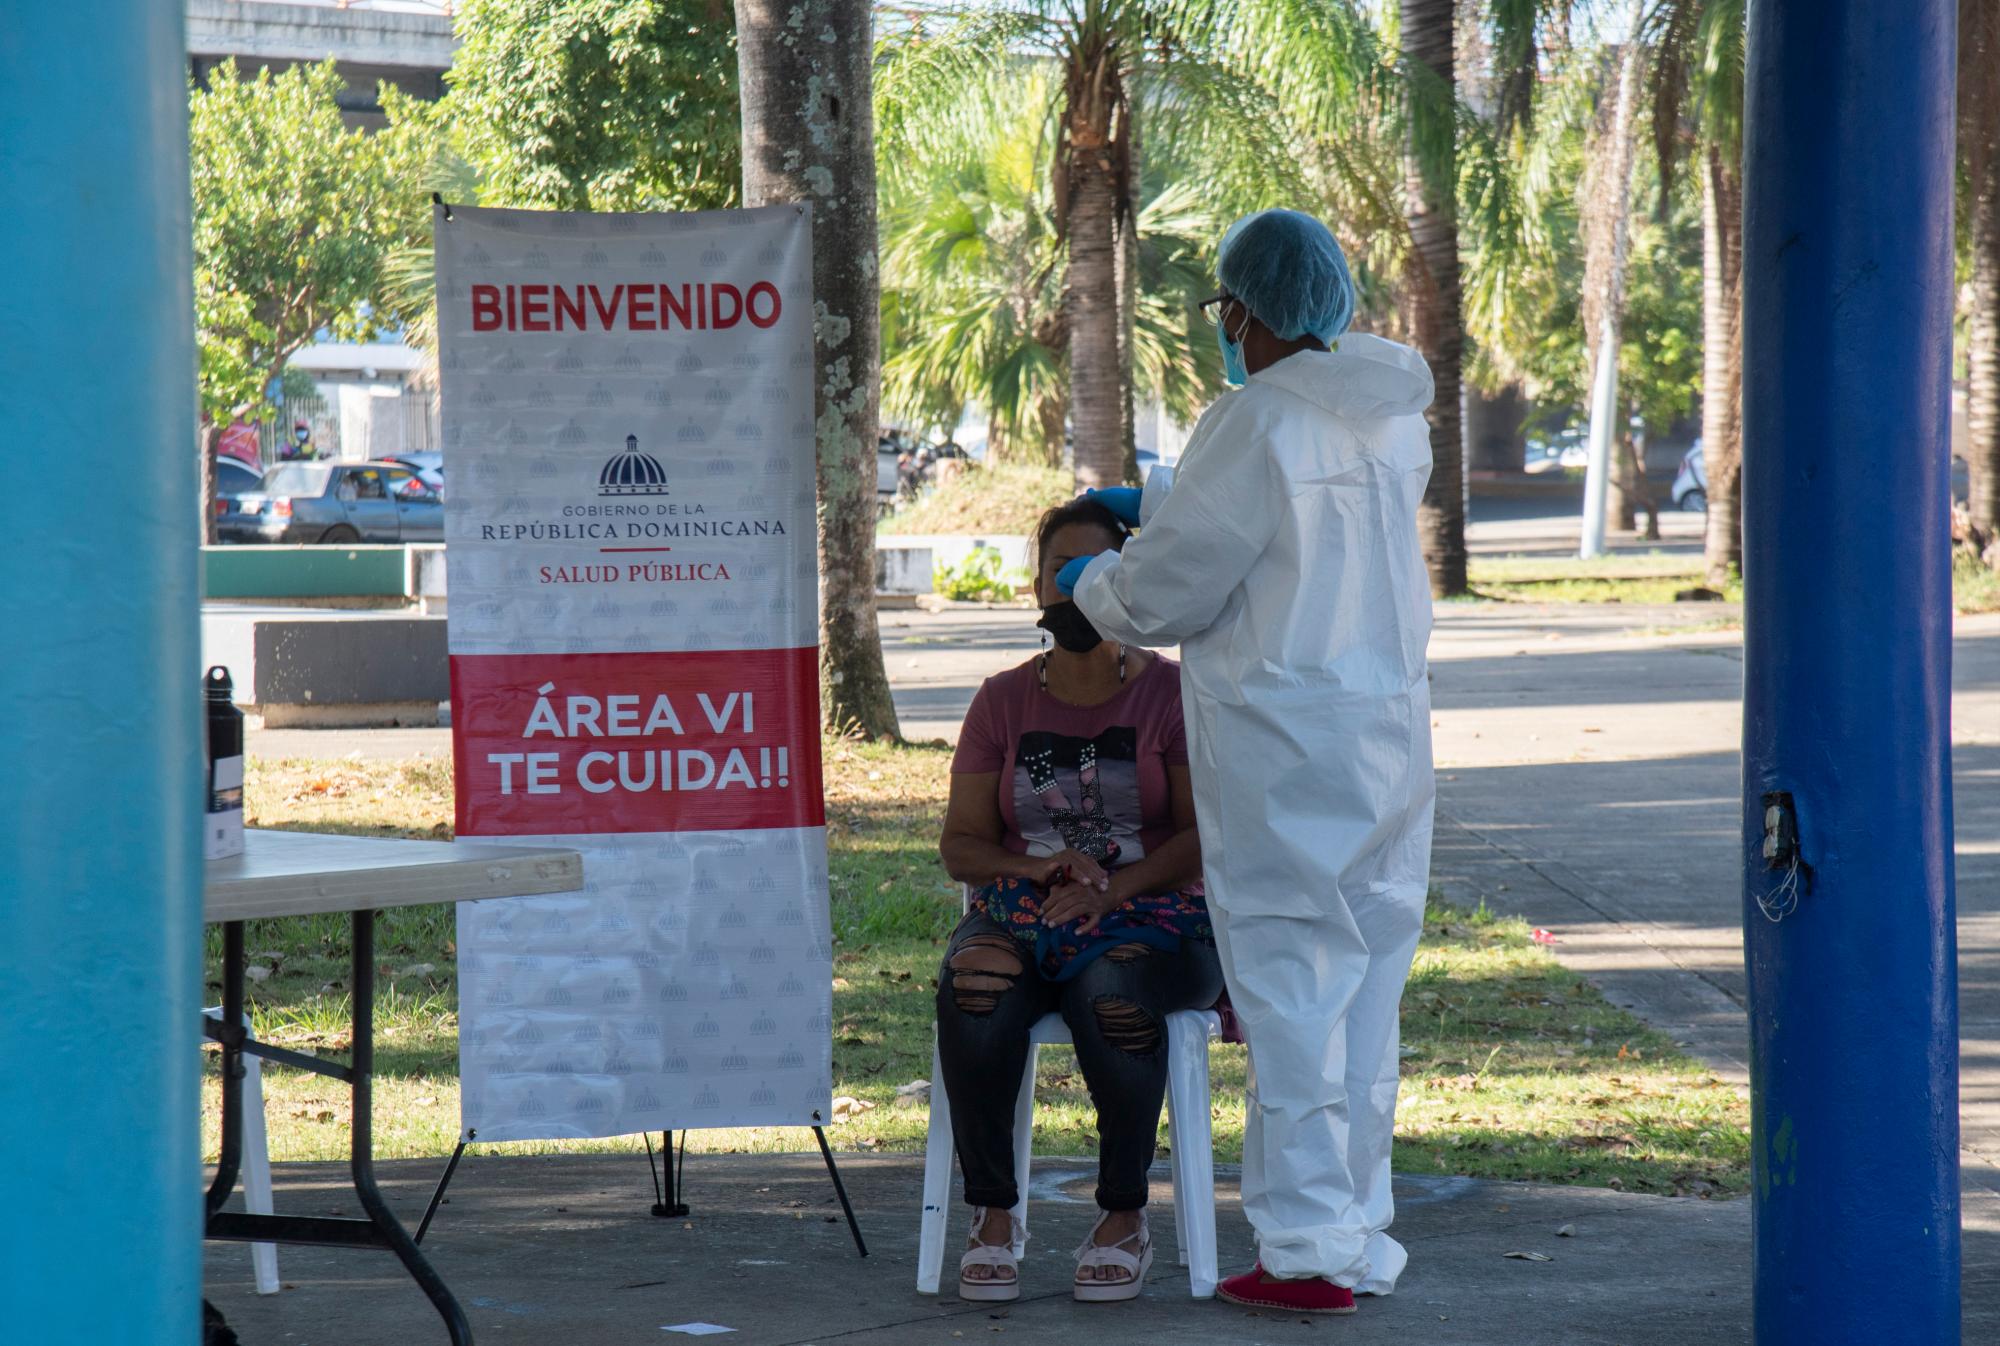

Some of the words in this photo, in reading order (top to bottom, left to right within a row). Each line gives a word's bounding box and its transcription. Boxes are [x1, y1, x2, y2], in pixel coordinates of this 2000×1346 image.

[473, 282, 781, 331] BIENVENIDO
[562, 504, 650, 517] GOBIERNO
[656, 504, 677, 515] DE
[684, 503, 705, 514] LA
[481, 520, 618, 540] REPÚBLICA
[628, 519, 786, 538] DOMINICANA
[539, 565, 620, 584] SALUD
[629, 560, 731, 582] PÚBLICA
[522, 681, 684, 738] ÁREA
[696, 692, 754, 734] VI
[488, 752, 561, 795] TE
[576, 746, 790, 794] CUIDA!!
